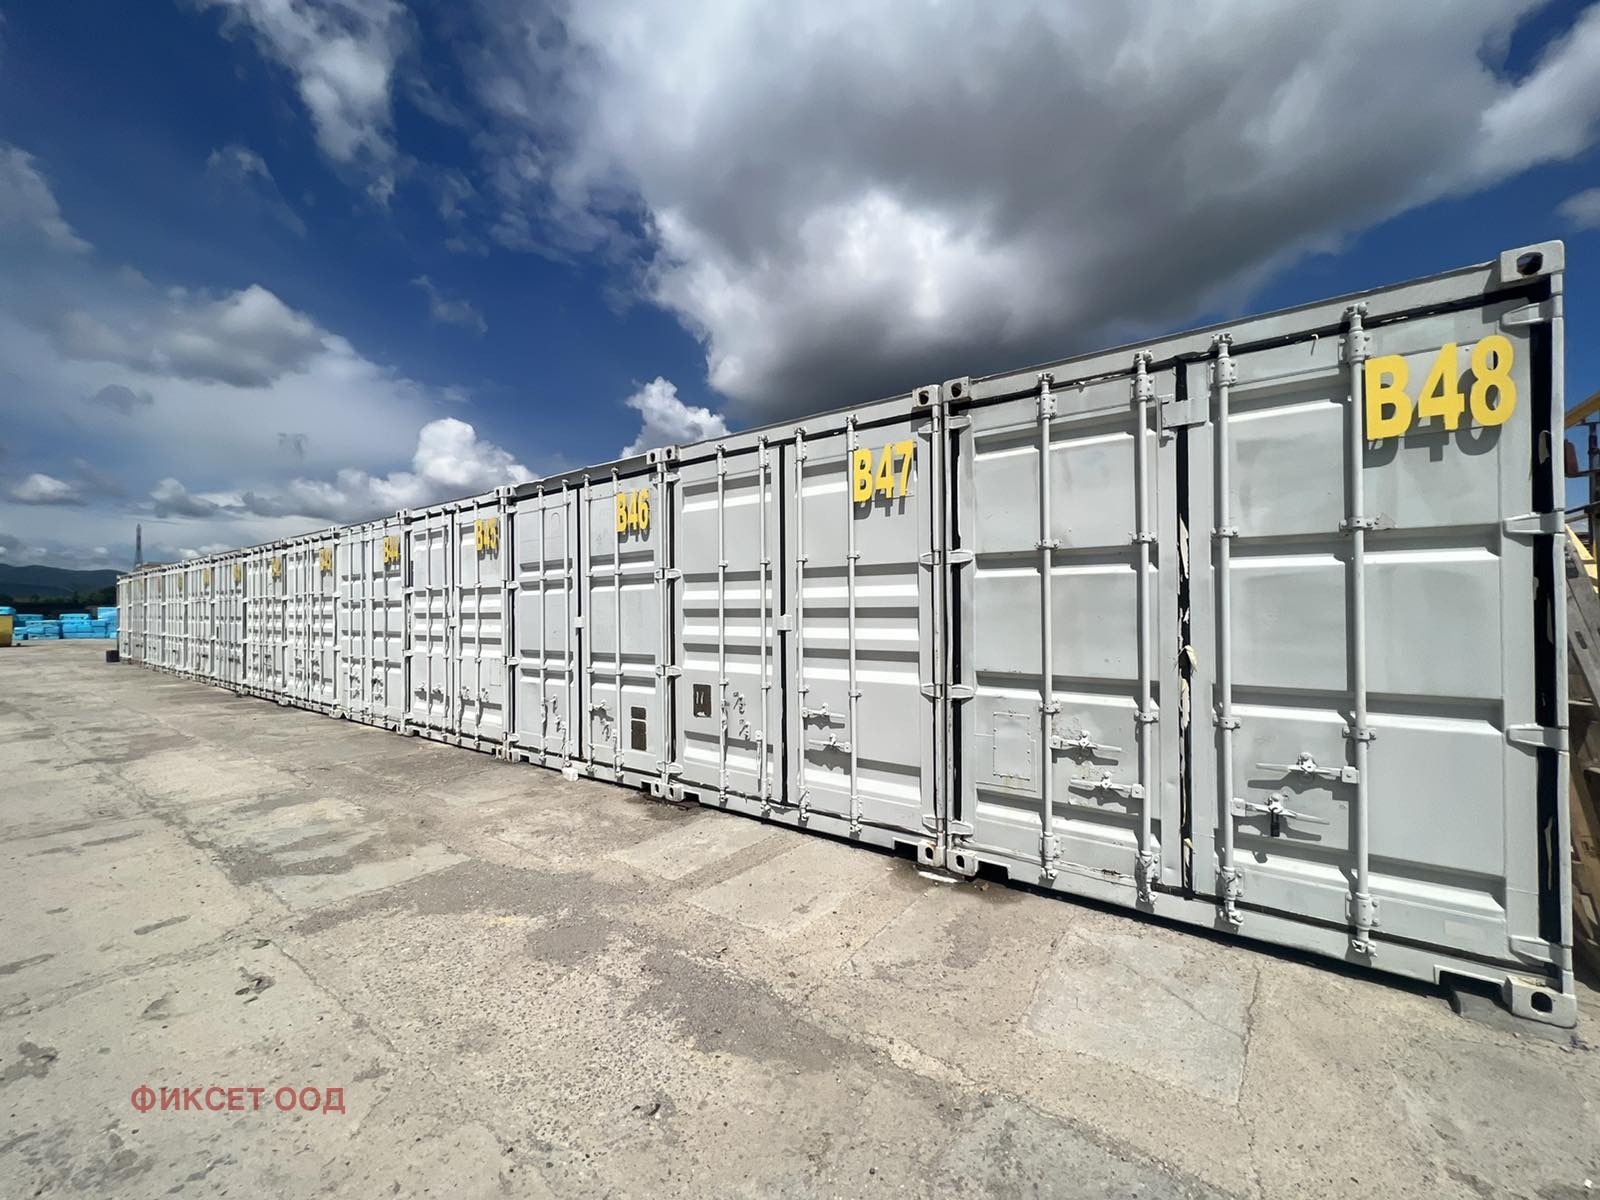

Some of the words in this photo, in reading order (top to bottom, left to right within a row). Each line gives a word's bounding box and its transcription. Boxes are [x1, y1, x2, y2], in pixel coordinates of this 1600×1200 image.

[1364, 335, 1518, 440] B48
[853, 440, 916, 503] B47
[616, 489, 650, 533] B46
